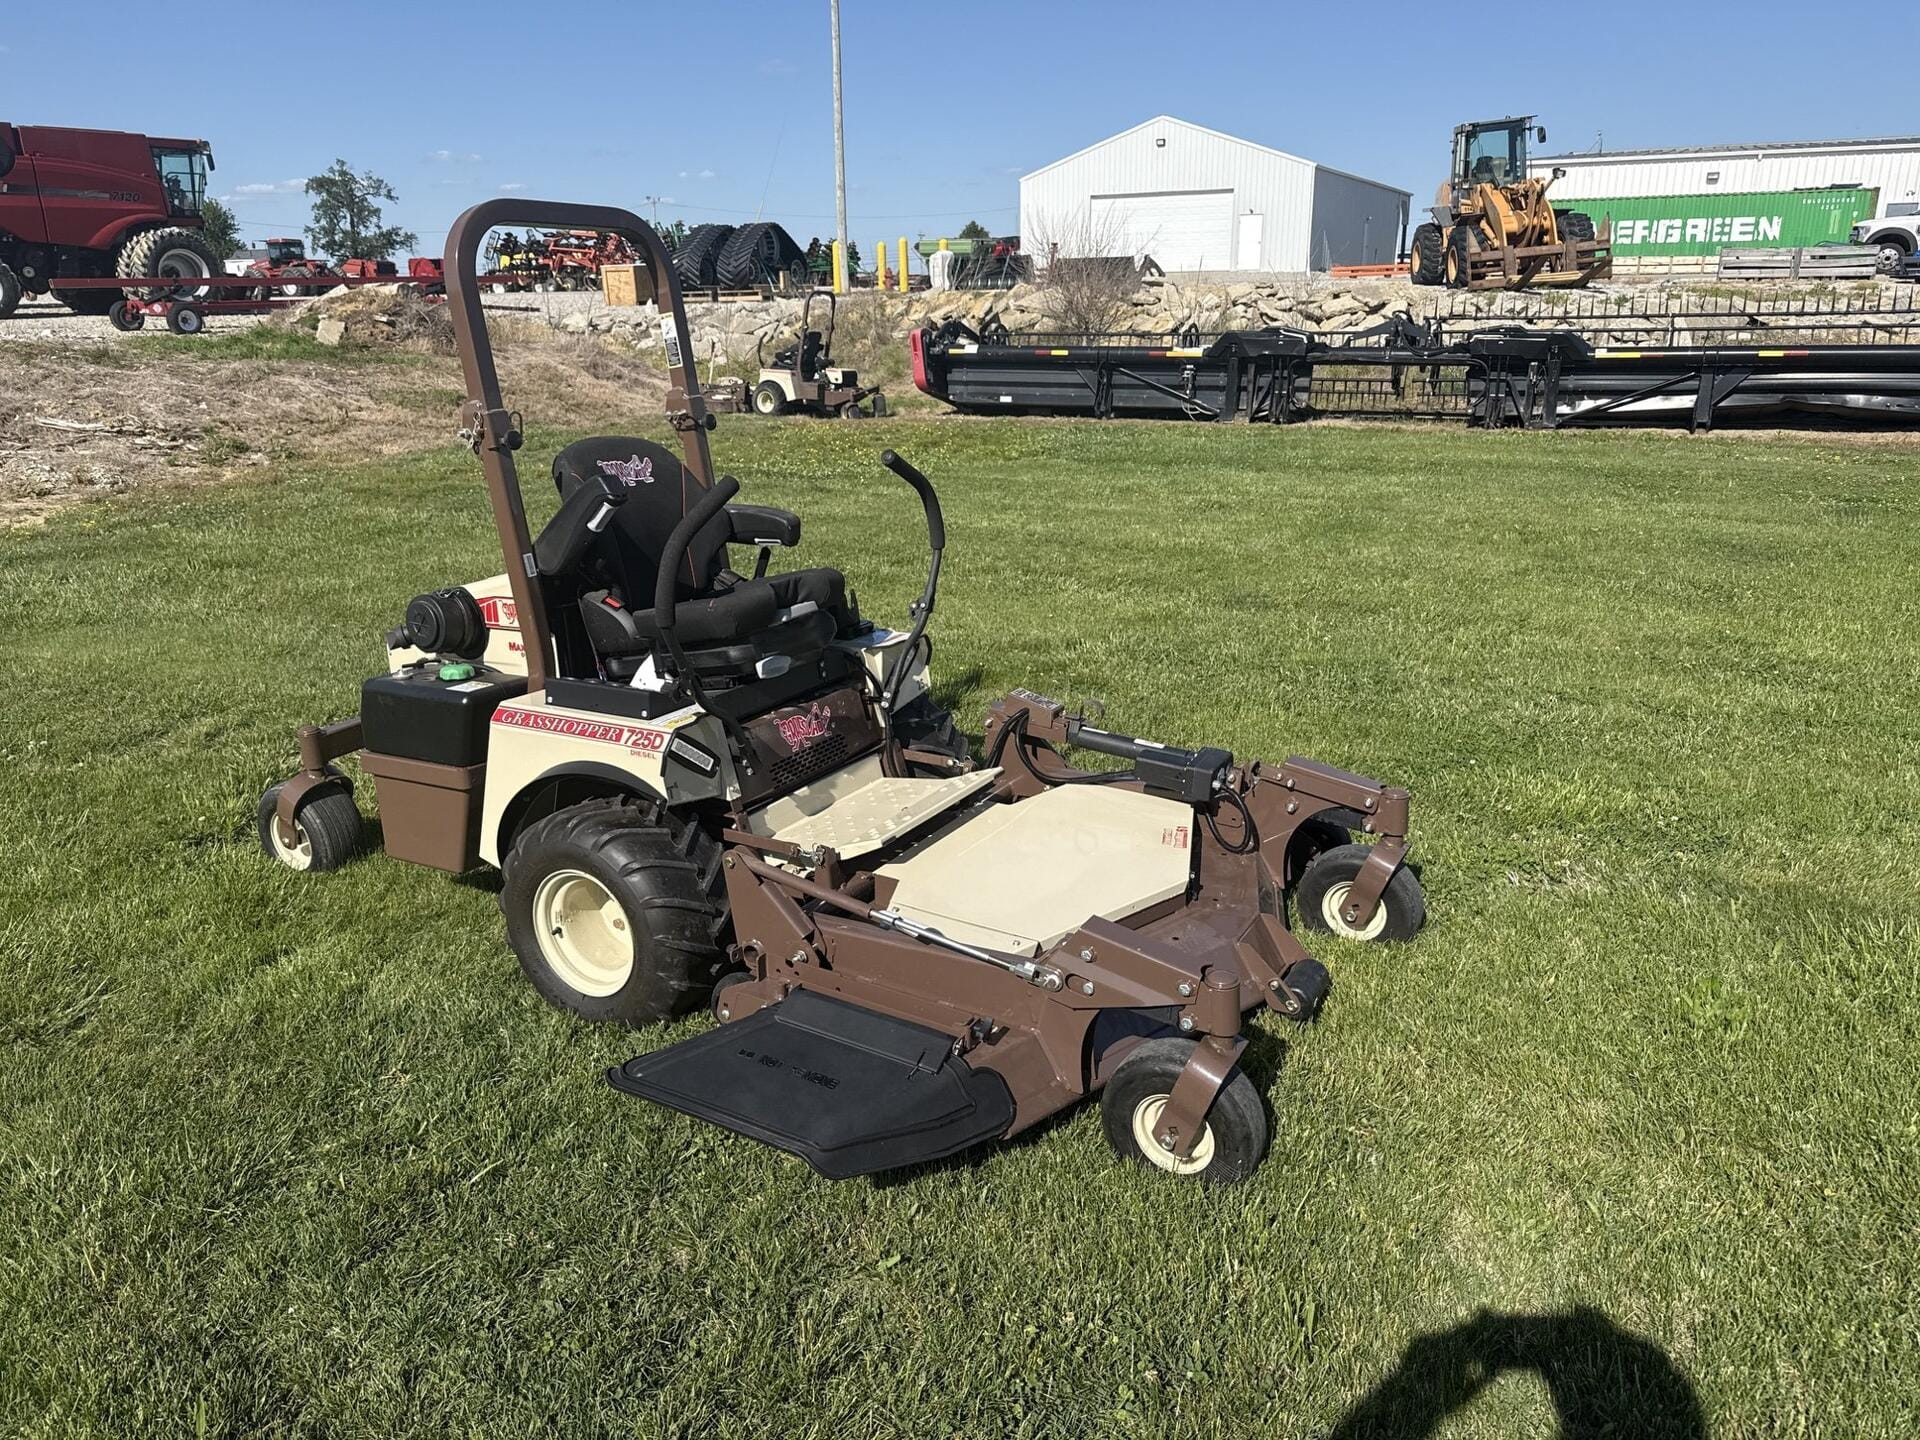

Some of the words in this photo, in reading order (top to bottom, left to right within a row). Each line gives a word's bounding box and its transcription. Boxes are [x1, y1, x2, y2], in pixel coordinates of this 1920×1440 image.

[501, 710, 619, 742] GRASSHOPPER
[624, 728, 665, 751] 725D
[629, 749, 658, 760] DIESEL
